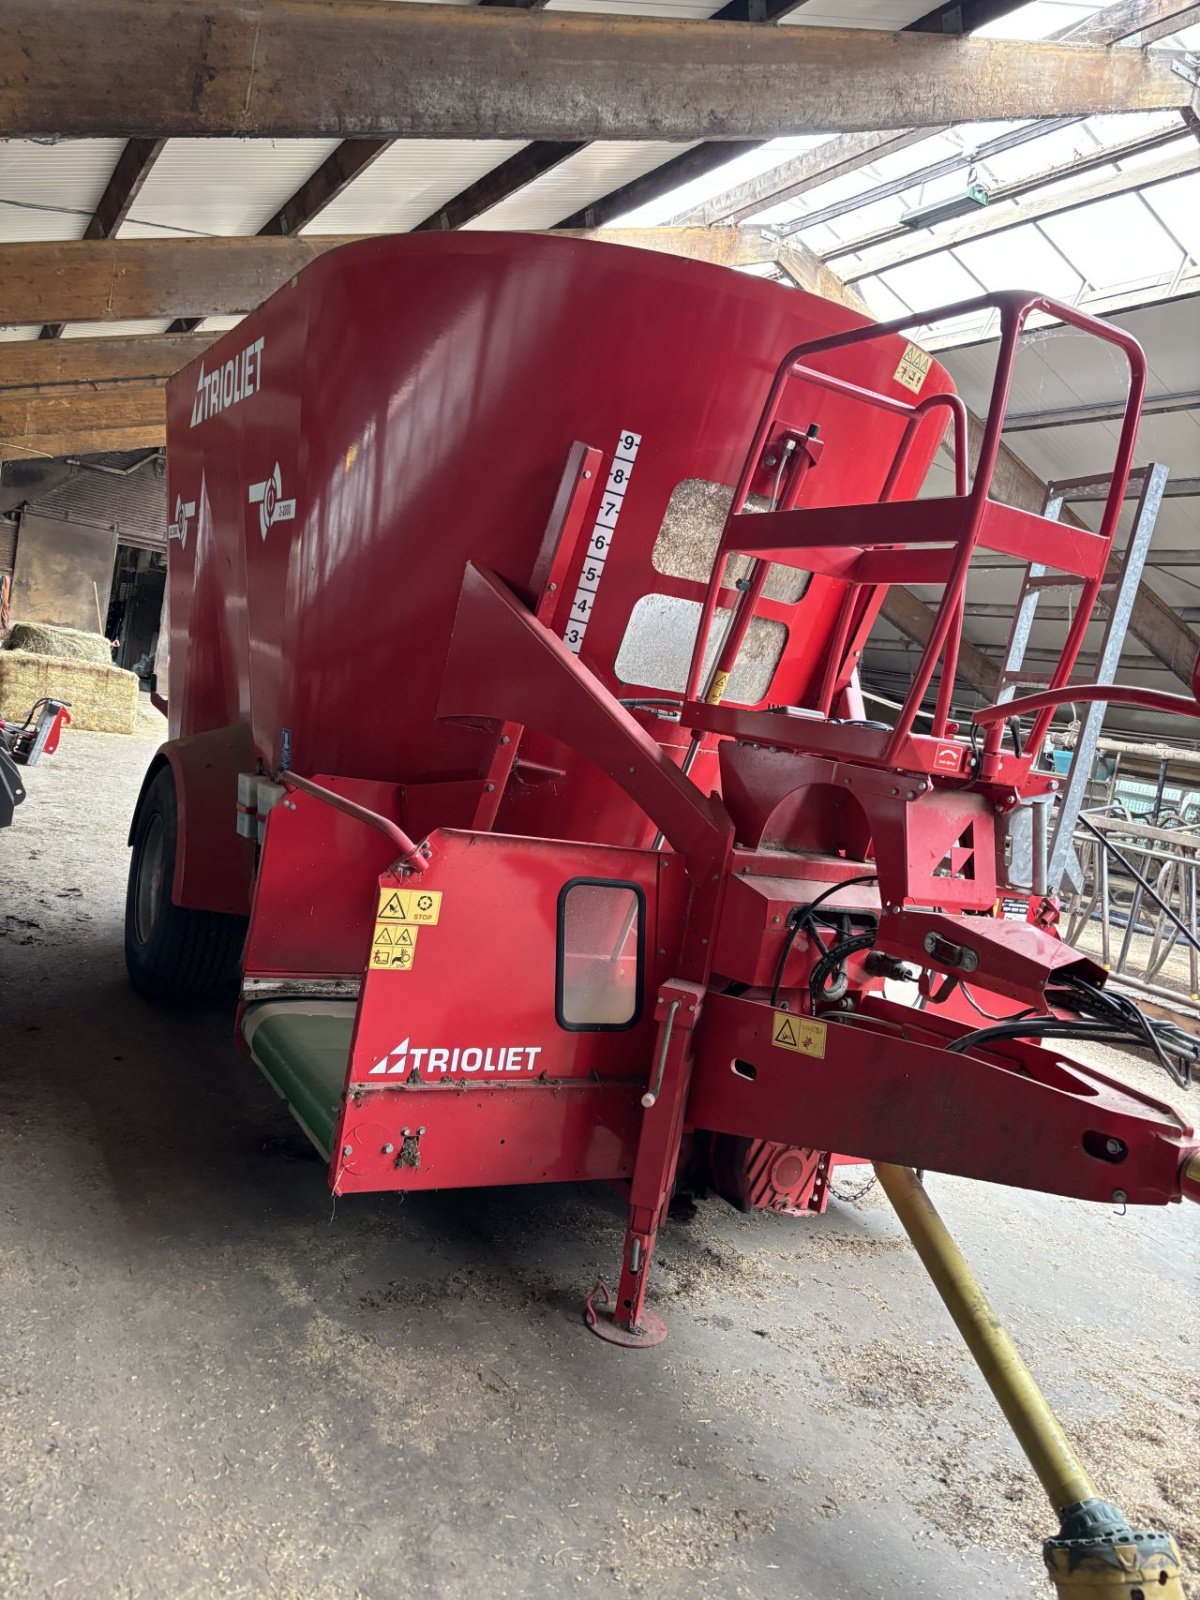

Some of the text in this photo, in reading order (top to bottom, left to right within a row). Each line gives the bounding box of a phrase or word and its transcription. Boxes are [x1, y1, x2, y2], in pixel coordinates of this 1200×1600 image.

[204, 335, 265, 420] TRIOLIET
[623, 435, 634, 450] 9
[613, 469, 624, 484] 8
[604, 502, 616, 517] 7
[595, 535, 605, 550] 6
[585, 567, 596, 582] 5
[577, 599, 587, 613] 4
[568, 630, 578, 643] 3
[410, 1047, 542, 1073] TRIOLIET
